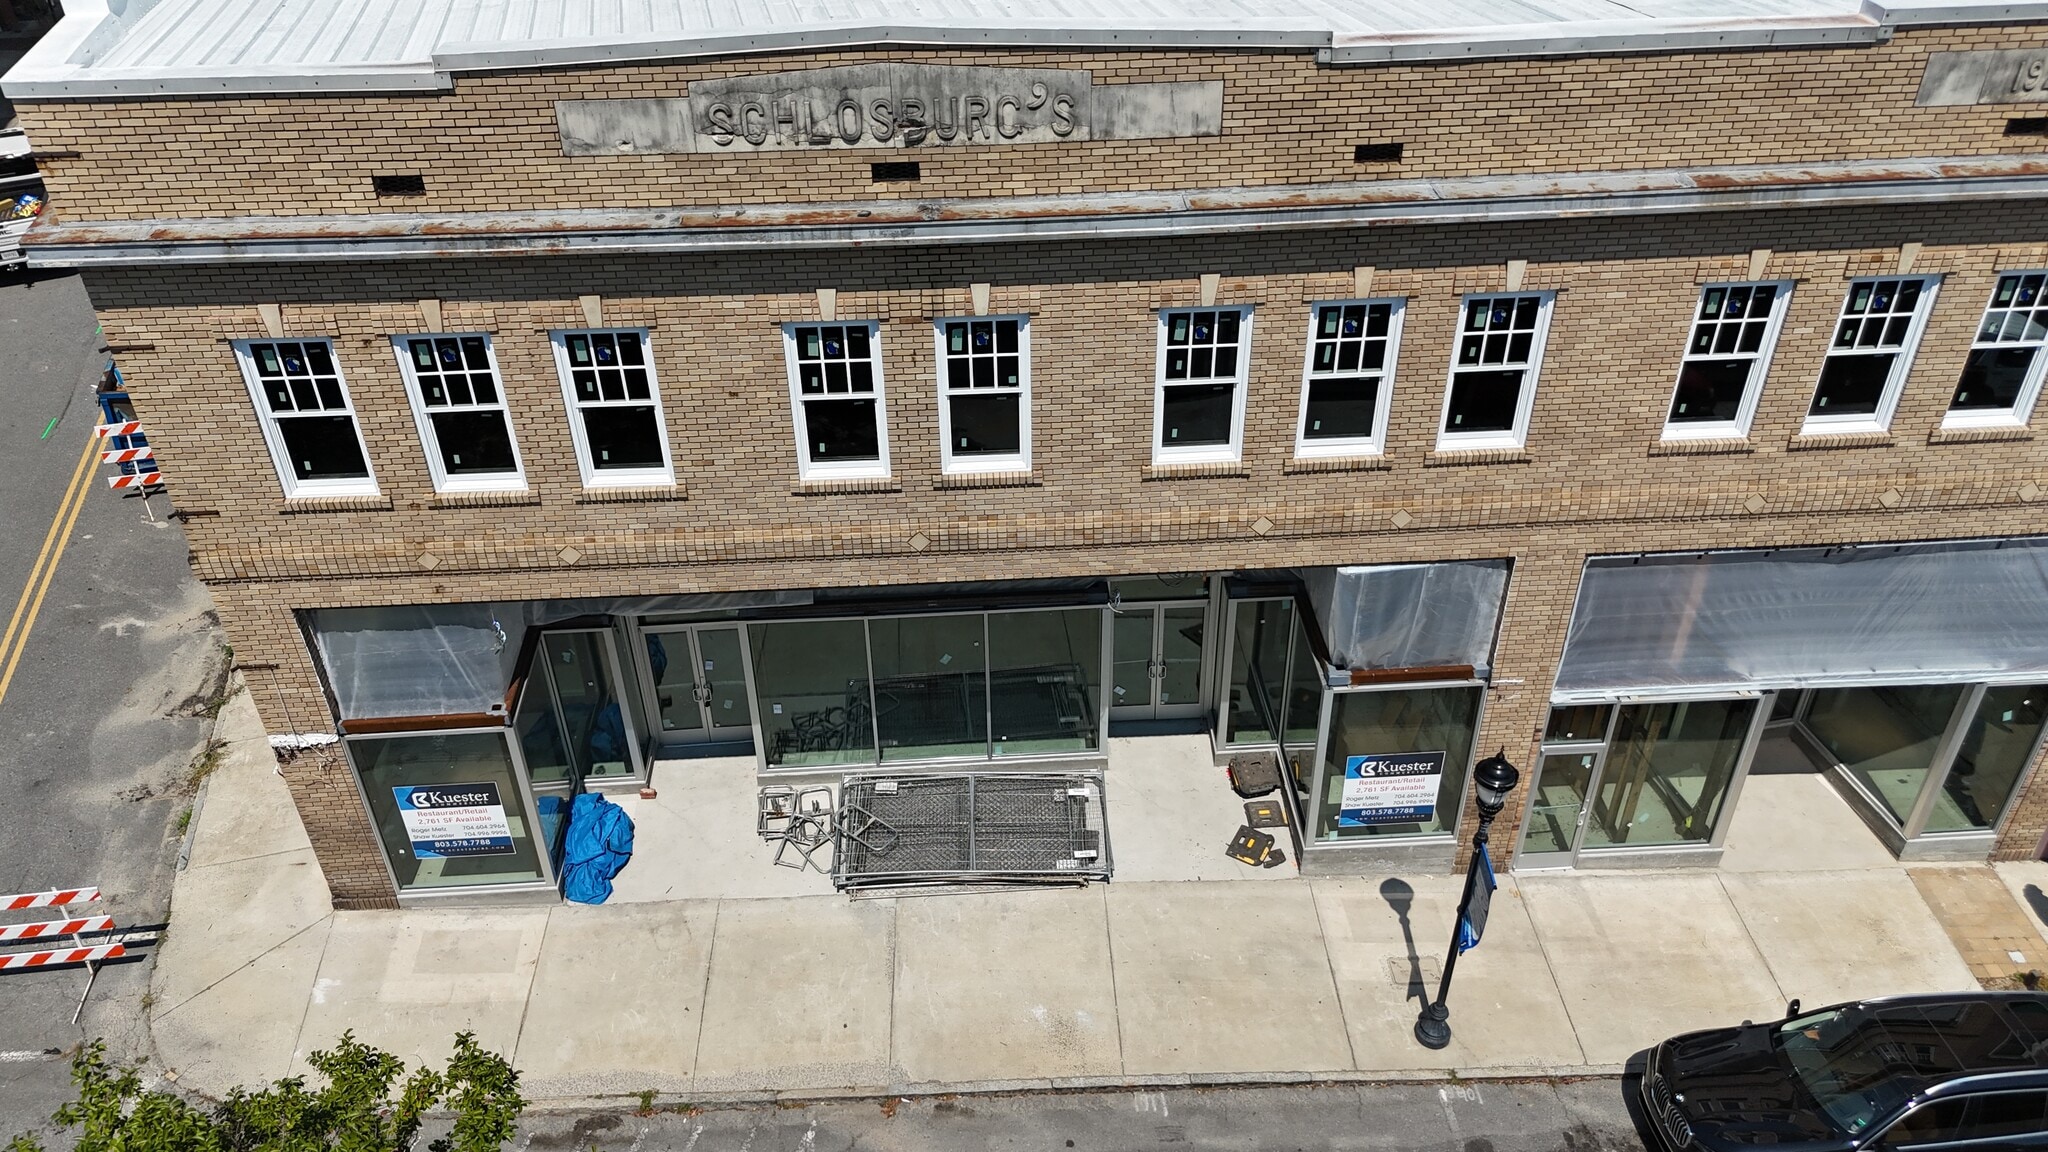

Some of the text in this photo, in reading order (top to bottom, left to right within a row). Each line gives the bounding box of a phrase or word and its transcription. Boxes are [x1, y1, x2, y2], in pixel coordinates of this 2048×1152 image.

[1377, 760, 1434, 773] Kuester
[1358, 777, 1426, 786] Restaurant/Retail
[1391, 784, 1426, 792] Available
[428, 791, 490, 804] Kuester
[416, 808, 488, 817] Restaurant/Retail
[1360, 807, 1415, 816] 803.578.7788
[434, 838, 491, 848] 803.578.7788
